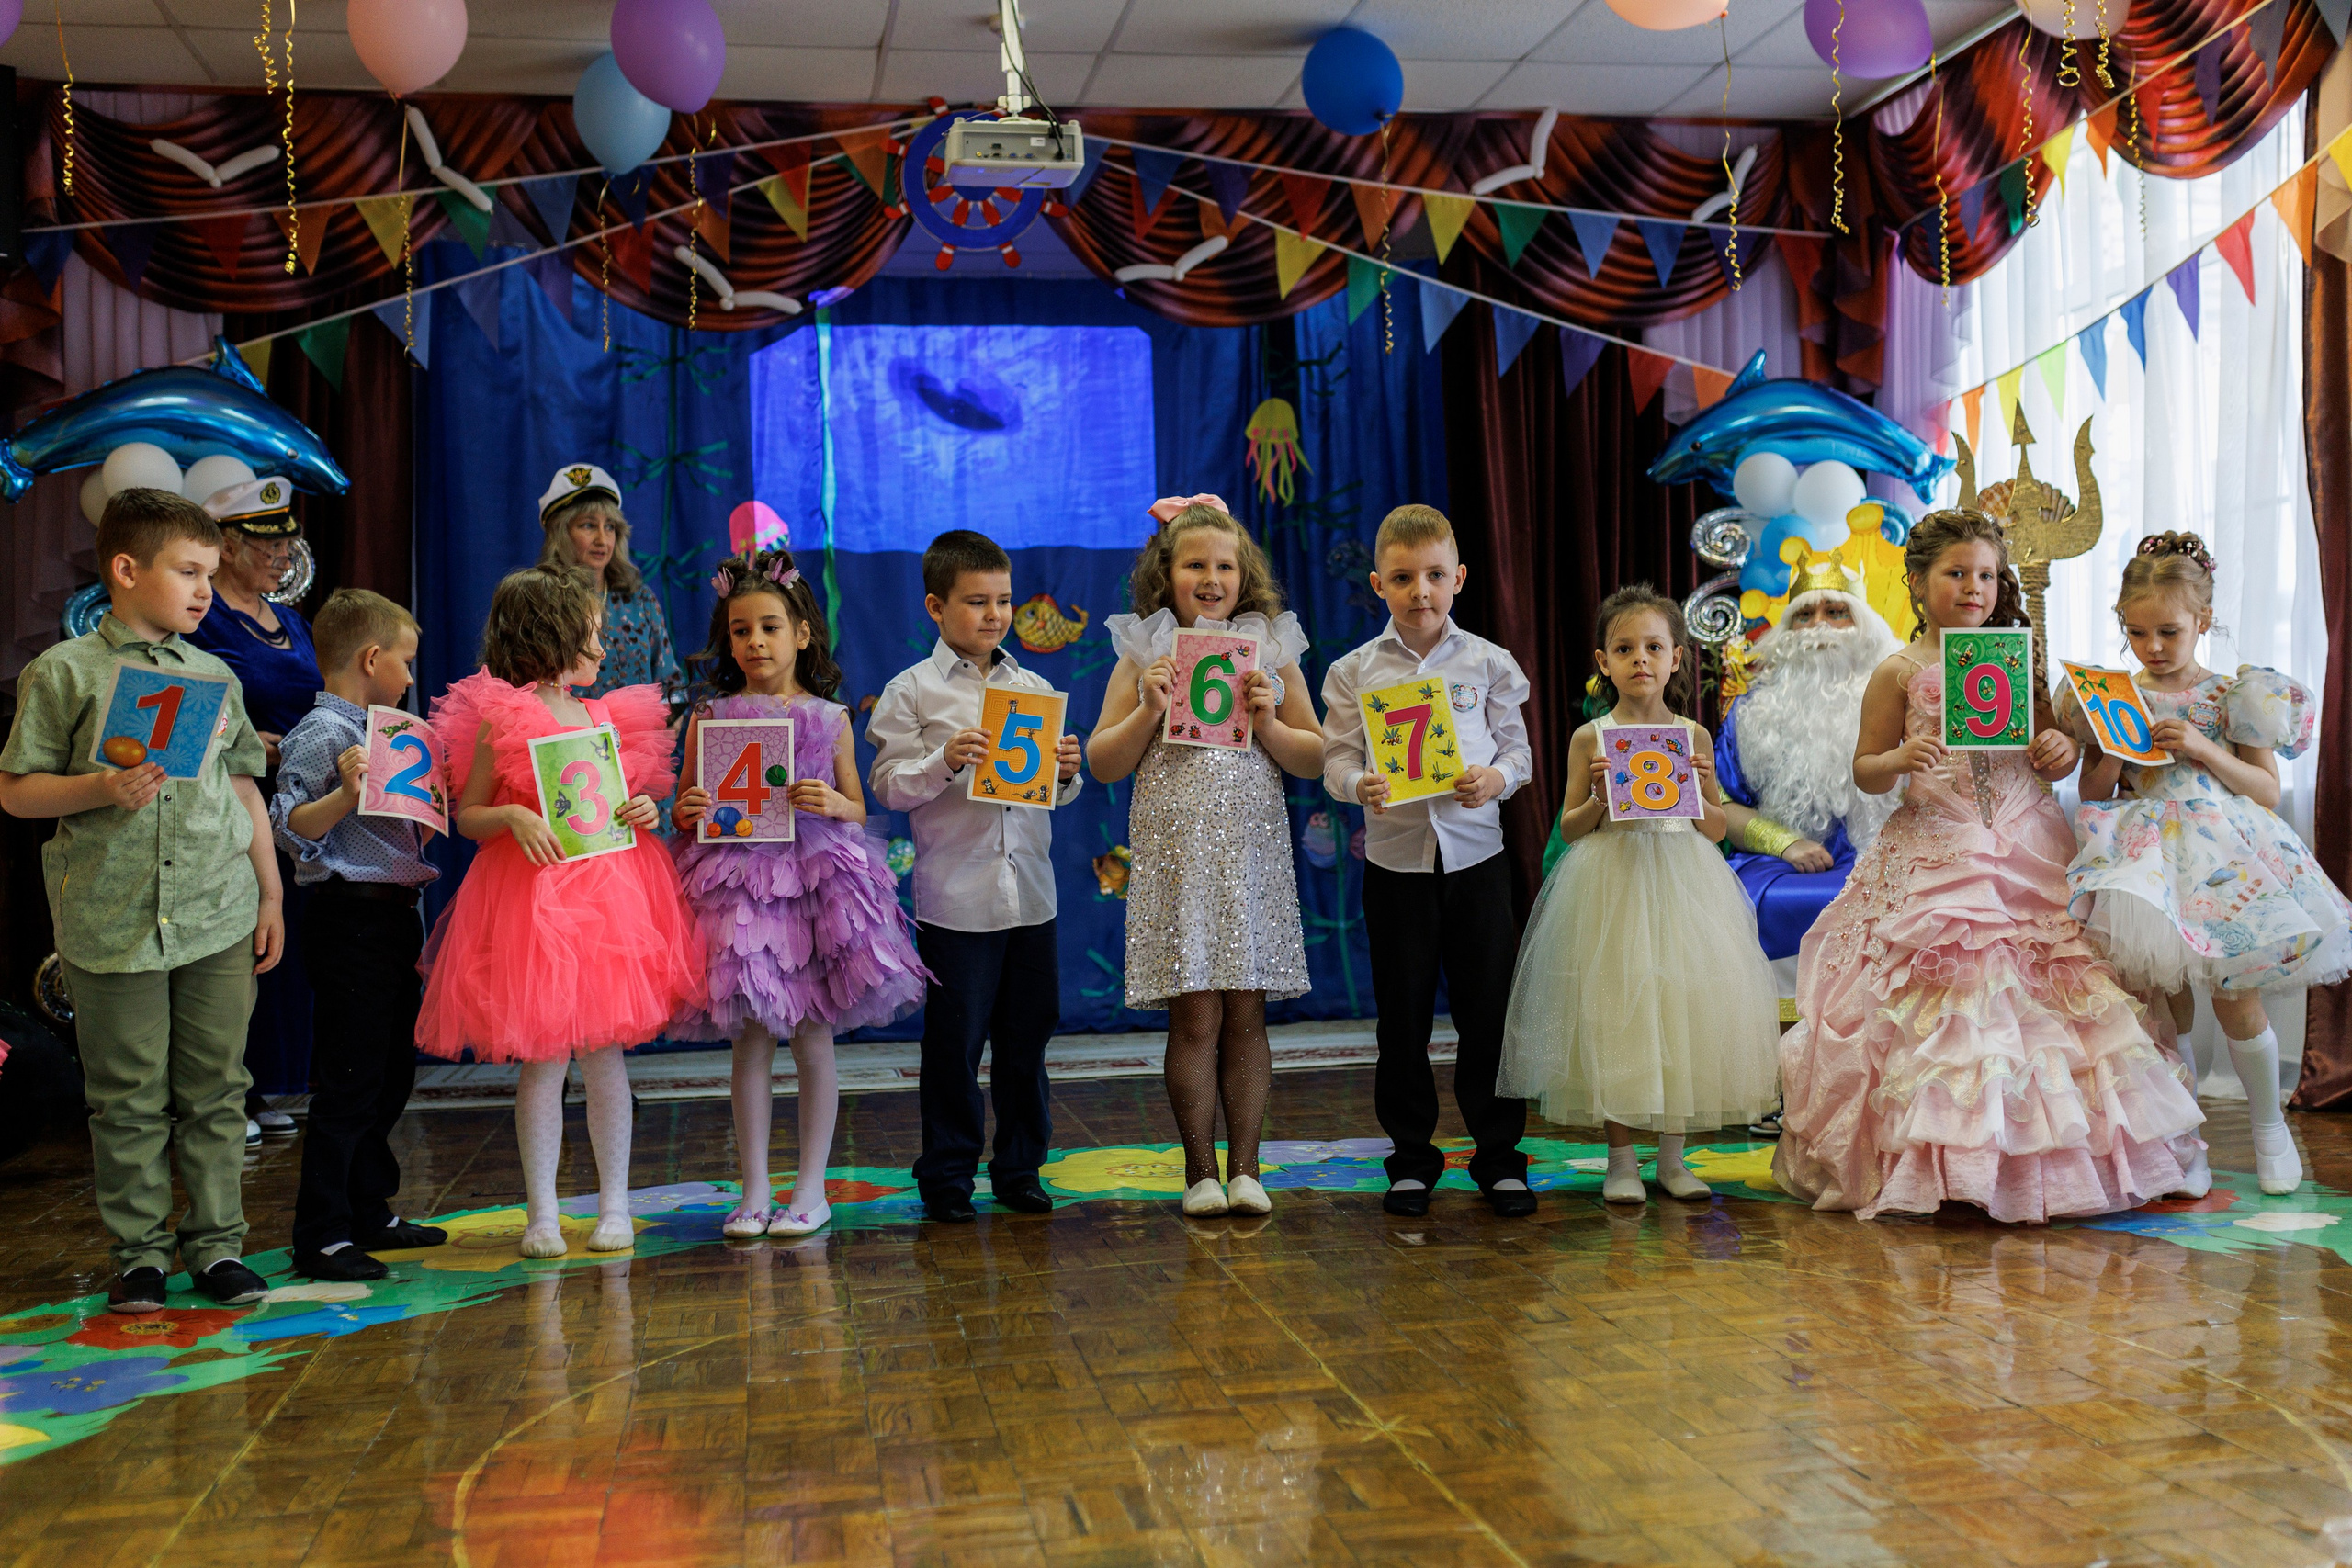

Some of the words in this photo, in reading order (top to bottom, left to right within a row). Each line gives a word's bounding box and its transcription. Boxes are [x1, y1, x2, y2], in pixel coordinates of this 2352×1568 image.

[137, 685, 184, 750] 1
[1189, 654, 1236, 726] 6
[1963, 663, 2012, 737] 9
[2086, 694, 2153, 753] 10
[383, 734, 432, 803] 2
[993, 712, 1043, 784] 5
[1385, 703, 1432, 780] 7
[560, 760, 610, 835] 3
[718, 742, 771, 816] 4
[1629, 750, 1679, 810] 8
